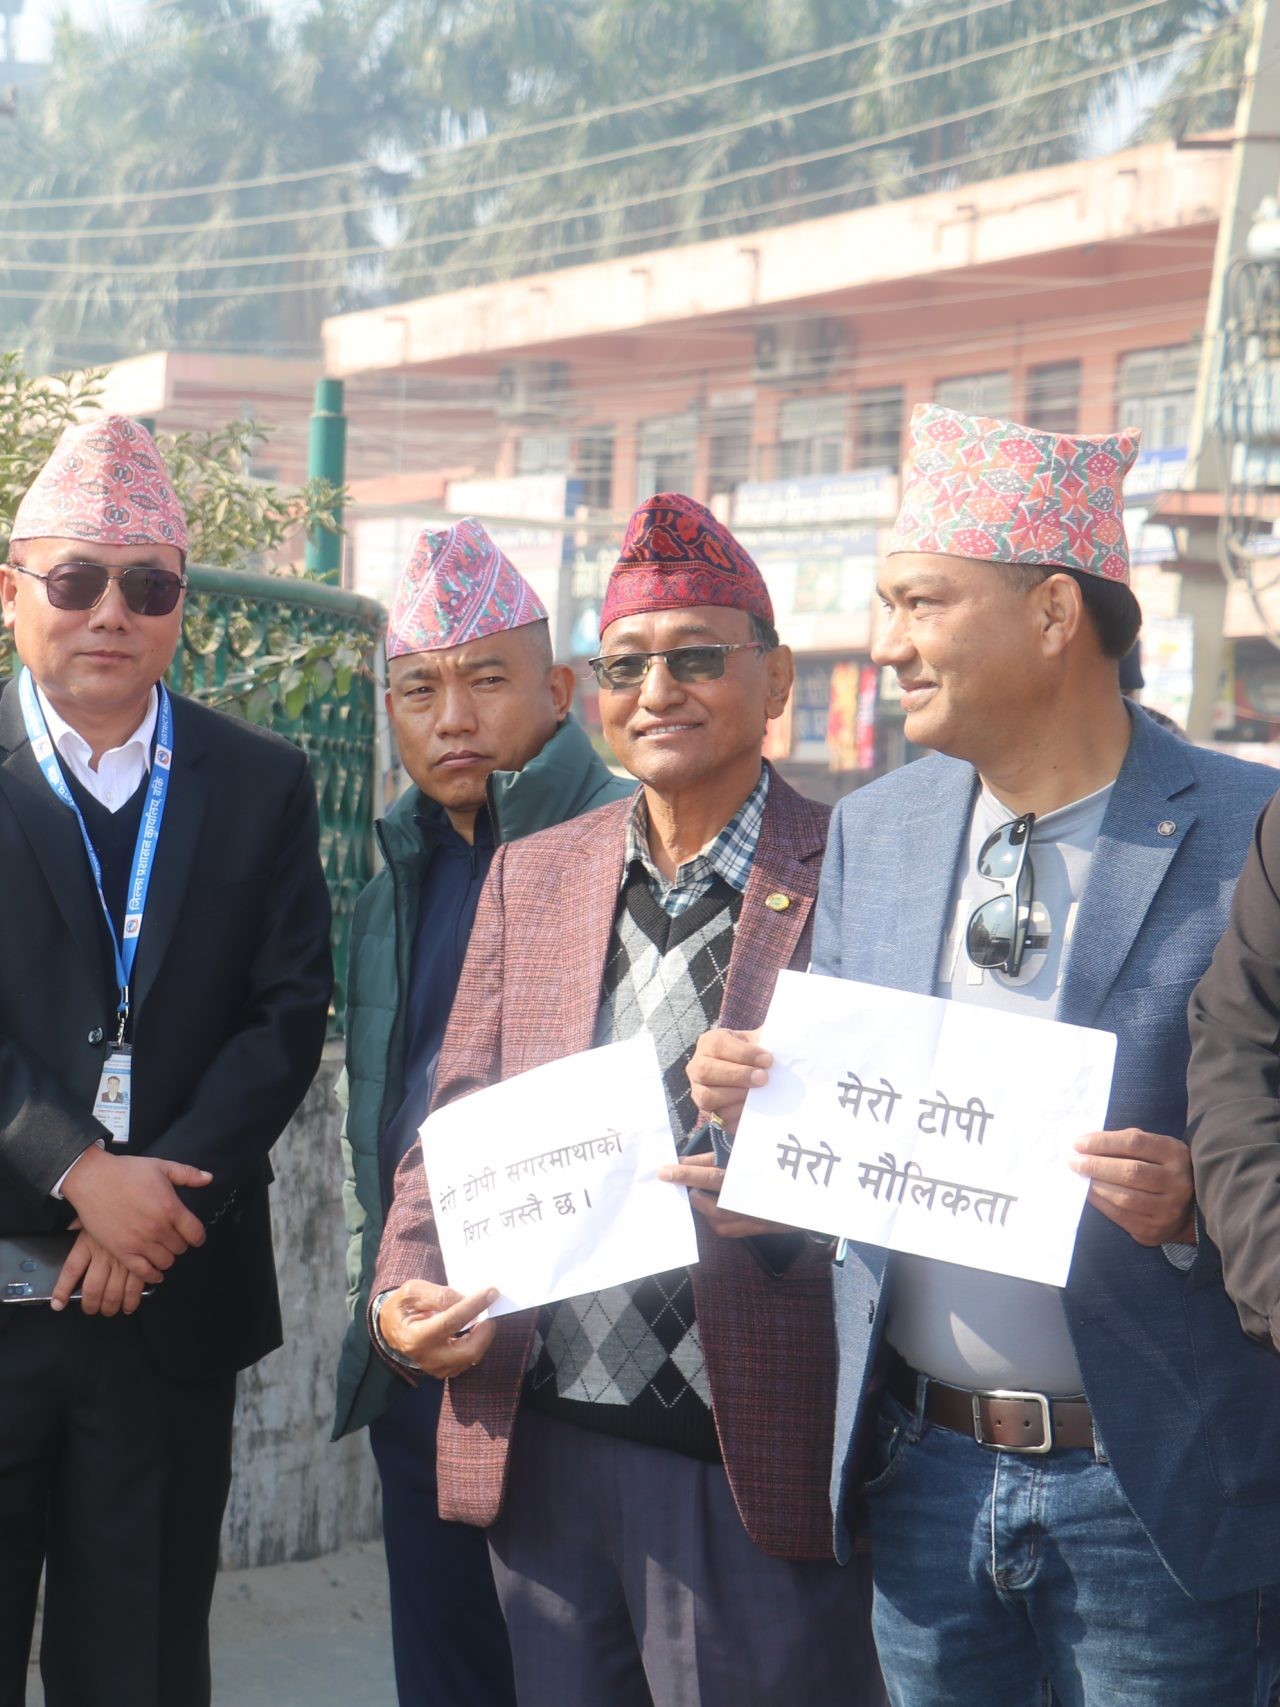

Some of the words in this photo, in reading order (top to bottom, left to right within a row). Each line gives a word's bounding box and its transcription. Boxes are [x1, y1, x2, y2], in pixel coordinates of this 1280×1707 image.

[160, 714, 169, 746] DISTRICT
[135, 839, 152, 877] प्रशासन
[129, 876, 144, 911] जिल्ला
[837, 1071, 902, 1124] मेरो
[918, 1090, 994, 1145] टोपी
[463, 1167, 496, 1201] टोपी
[505, 1128, 623, 1184] सगरमाथाको
[777, 1134, 841, 1187] मेरो
[858, 1152, 1018, 1227] मौलिकता
[463, 1217, 491, 1247] शिर
[500, 1194, 543, 1229] जस्तै
